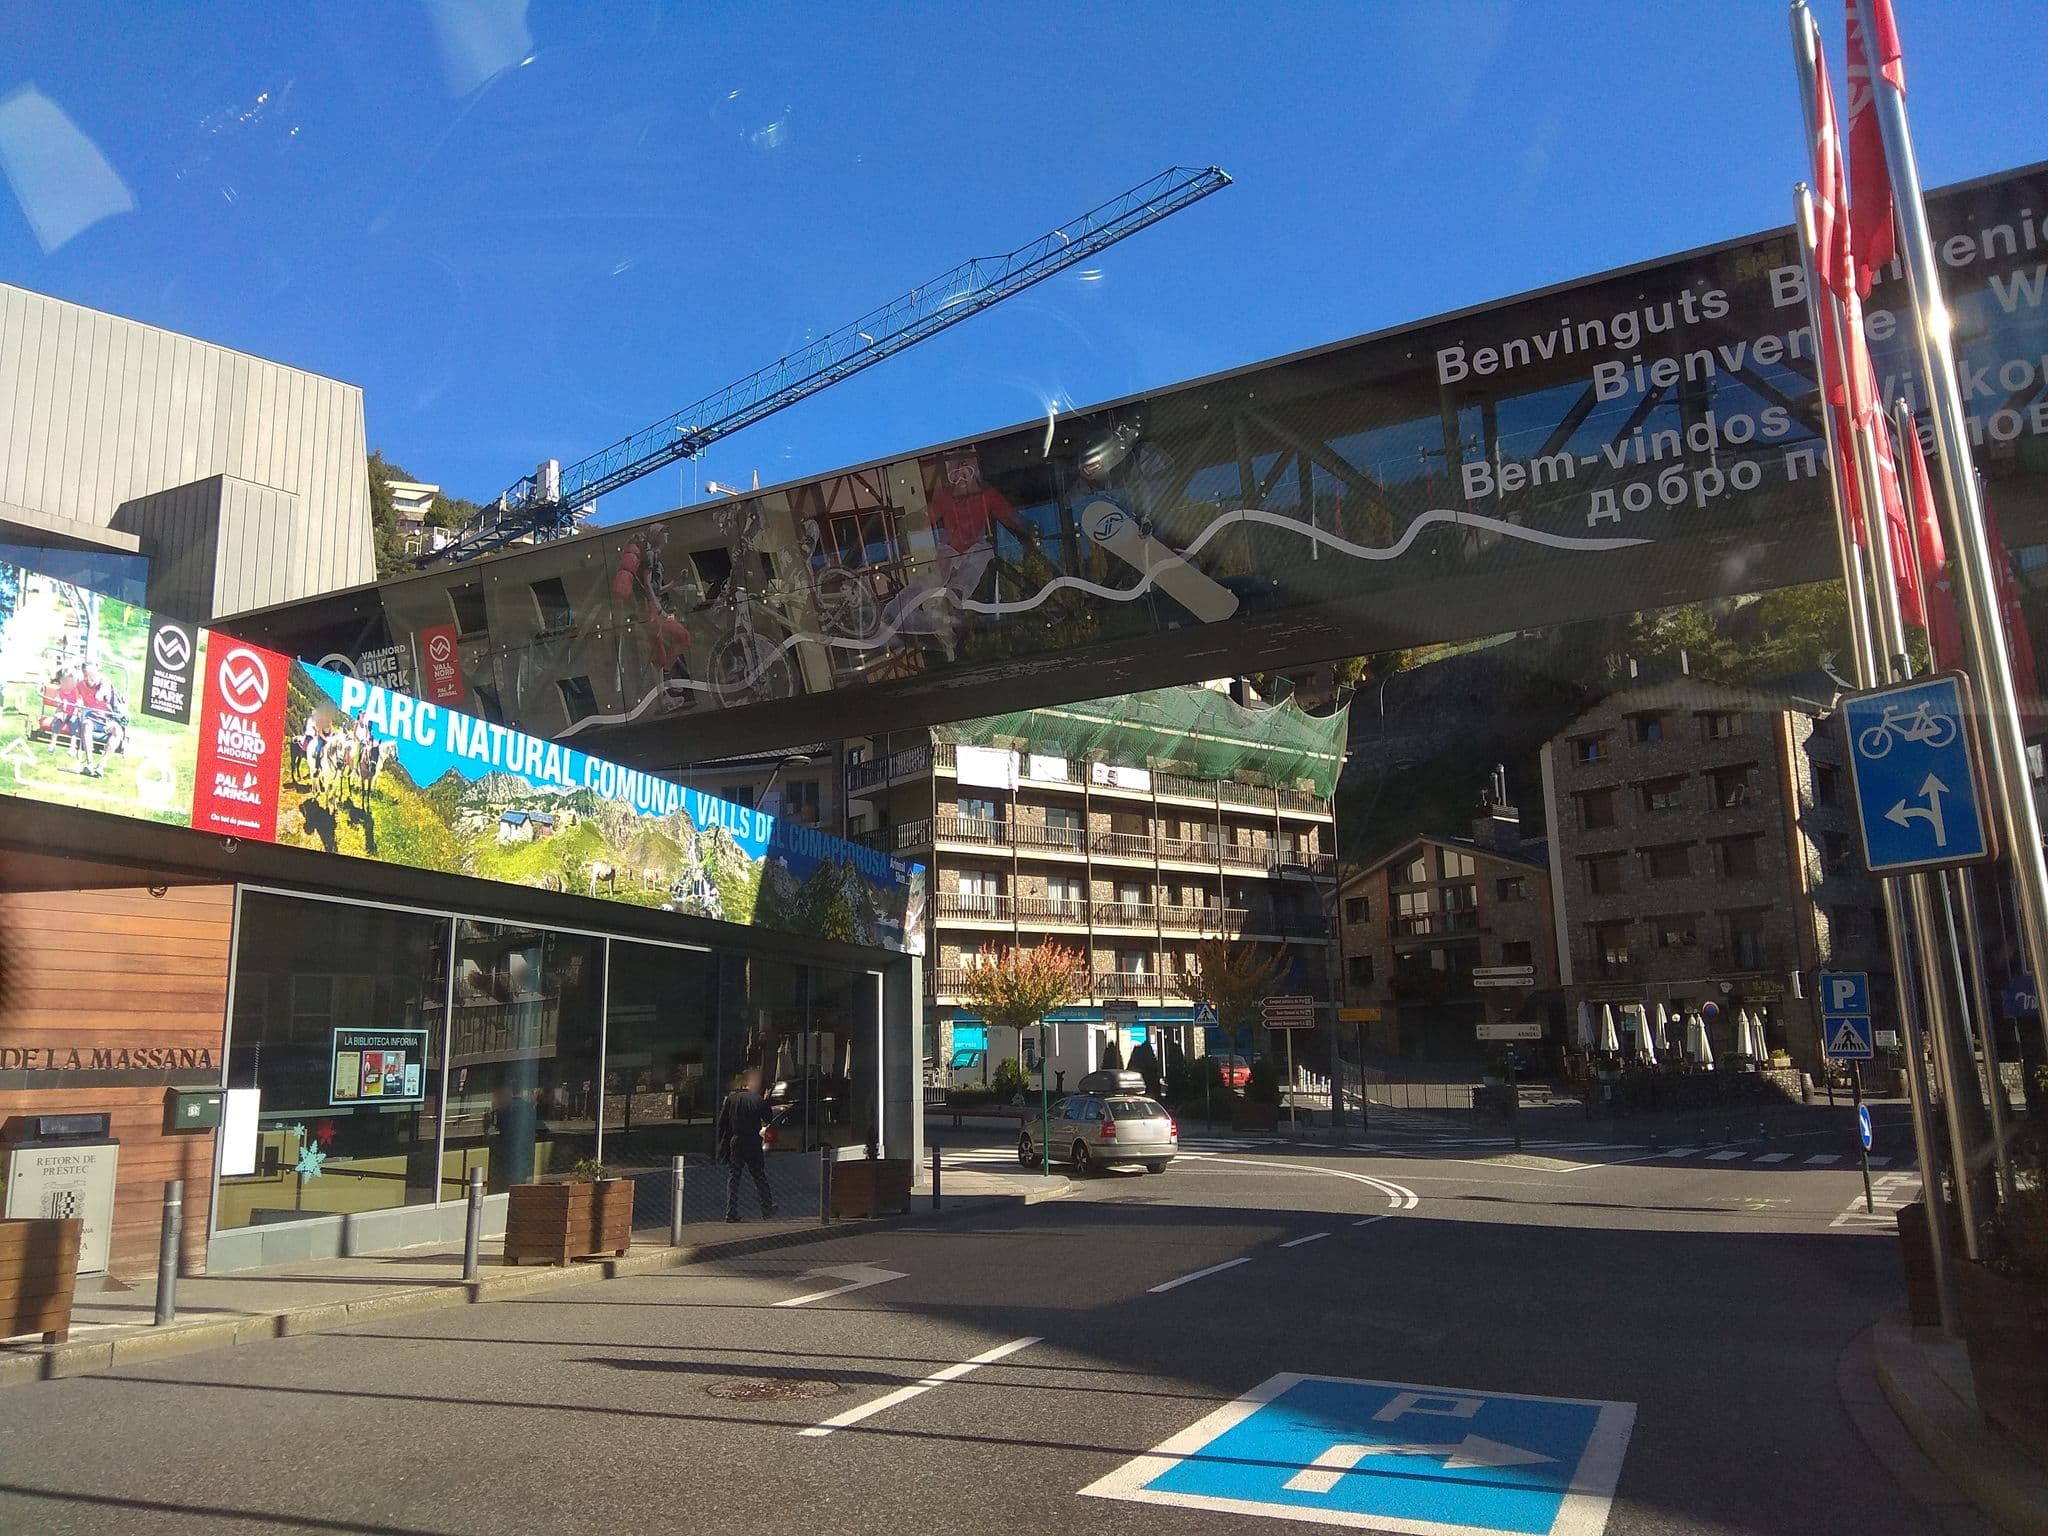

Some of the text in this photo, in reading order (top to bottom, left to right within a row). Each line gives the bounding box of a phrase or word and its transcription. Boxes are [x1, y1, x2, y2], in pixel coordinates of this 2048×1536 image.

[1437, 282, 1730, 385] Benvinguts
[1593, 309, 1897, 402] Bienvene
[1461, 402, 1791, 500] Bem-vindos
[1586, 459, 1762, 527] добро
[362, 645, 406, 660] VALLNORD
[362, 657, 396, 675] BIKE
[434, 668, 455, 678] NORD
[152, 676, 178, 692] BIKE
[151, 686, 184, 706] PARK
[219, 713, 260, 737] VALL
[217, 731, 265, 755] NORD
[216, 746, 258, 762] ANDORRA
[341, 676, 436, 746] PARC
[447, 711, 577, 787] NATURAL
[584, 755, 687, 817] COMUNAL
[697, 791, 750, 838] VALLS
[215, 772, 238, 787] PAL
[213, 787, 261, 805] ARINSAL
[1832, 980, 1856, 1009] P
[344, 1037, 418, 1046] LA BIBLIOTECA INFORMA
[0, 1048, 212, 1071] DE LA MASSANA
[36, 1154, 97, 1166] RETORN DE
[43, 1165, 89, 1176] PRESTEC
